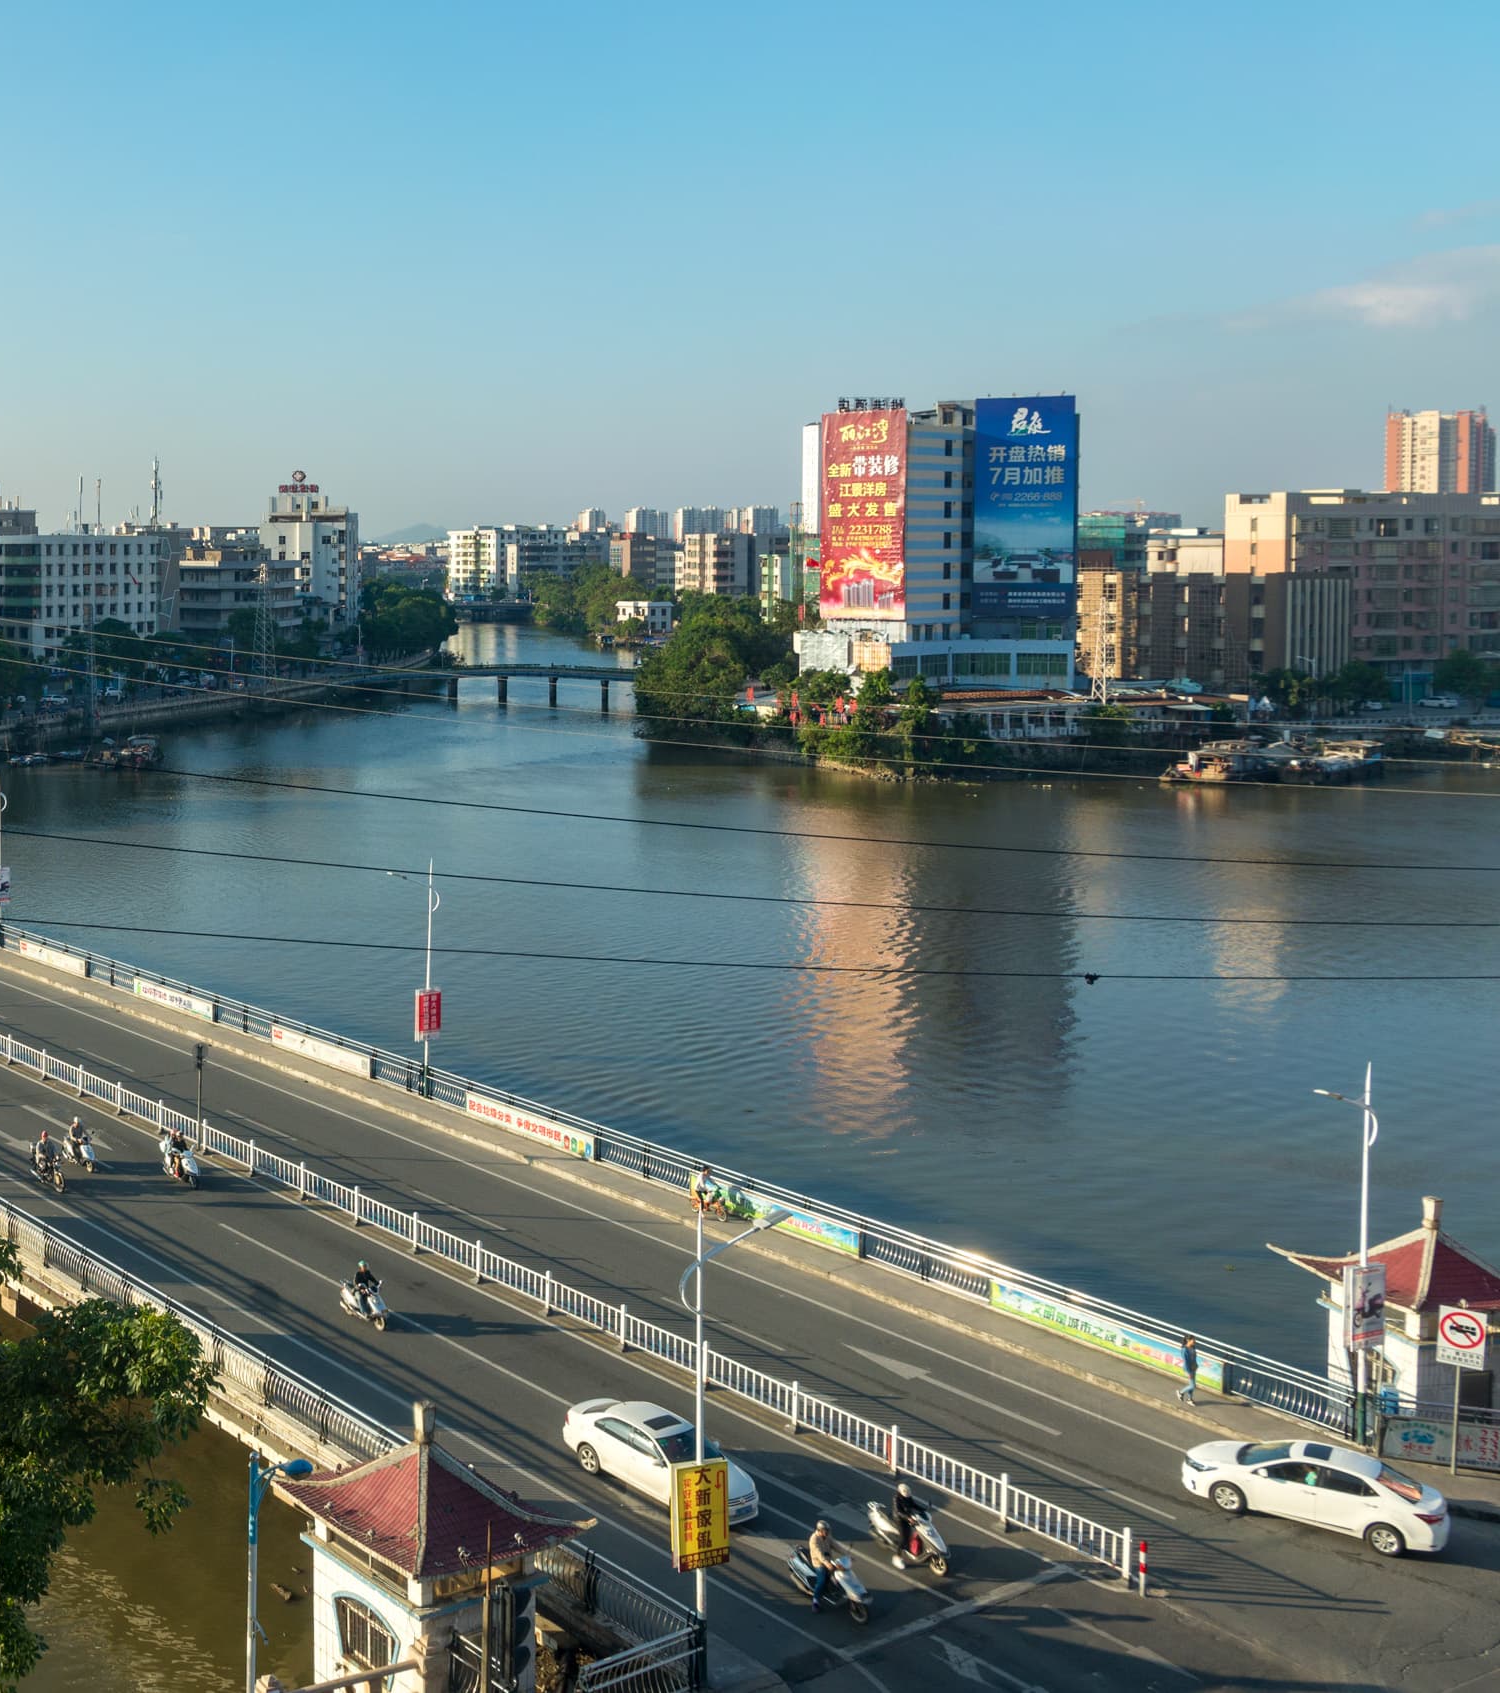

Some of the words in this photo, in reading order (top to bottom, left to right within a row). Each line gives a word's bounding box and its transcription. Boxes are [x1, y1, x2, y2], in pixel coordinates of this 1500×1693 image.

[839, 419, 889, 443] 丽江湾
[989, 444, 1066, 463] 开盘热销
[828, 455, 899, 477] 全新带装修
[989, 466, 1065, 485] 7月加推
[840, 482, 887, 497] 江景洋房
[828, 502, 897, 517] 盛大发售
[849, 524, 892, 534] 2231788
[468, 1099, 512, 1125] 配合垃圾分类
[516, 1117, 561, 1142] 争做文明市民
[695, 1468, 712, 1549] 大新傢俬
